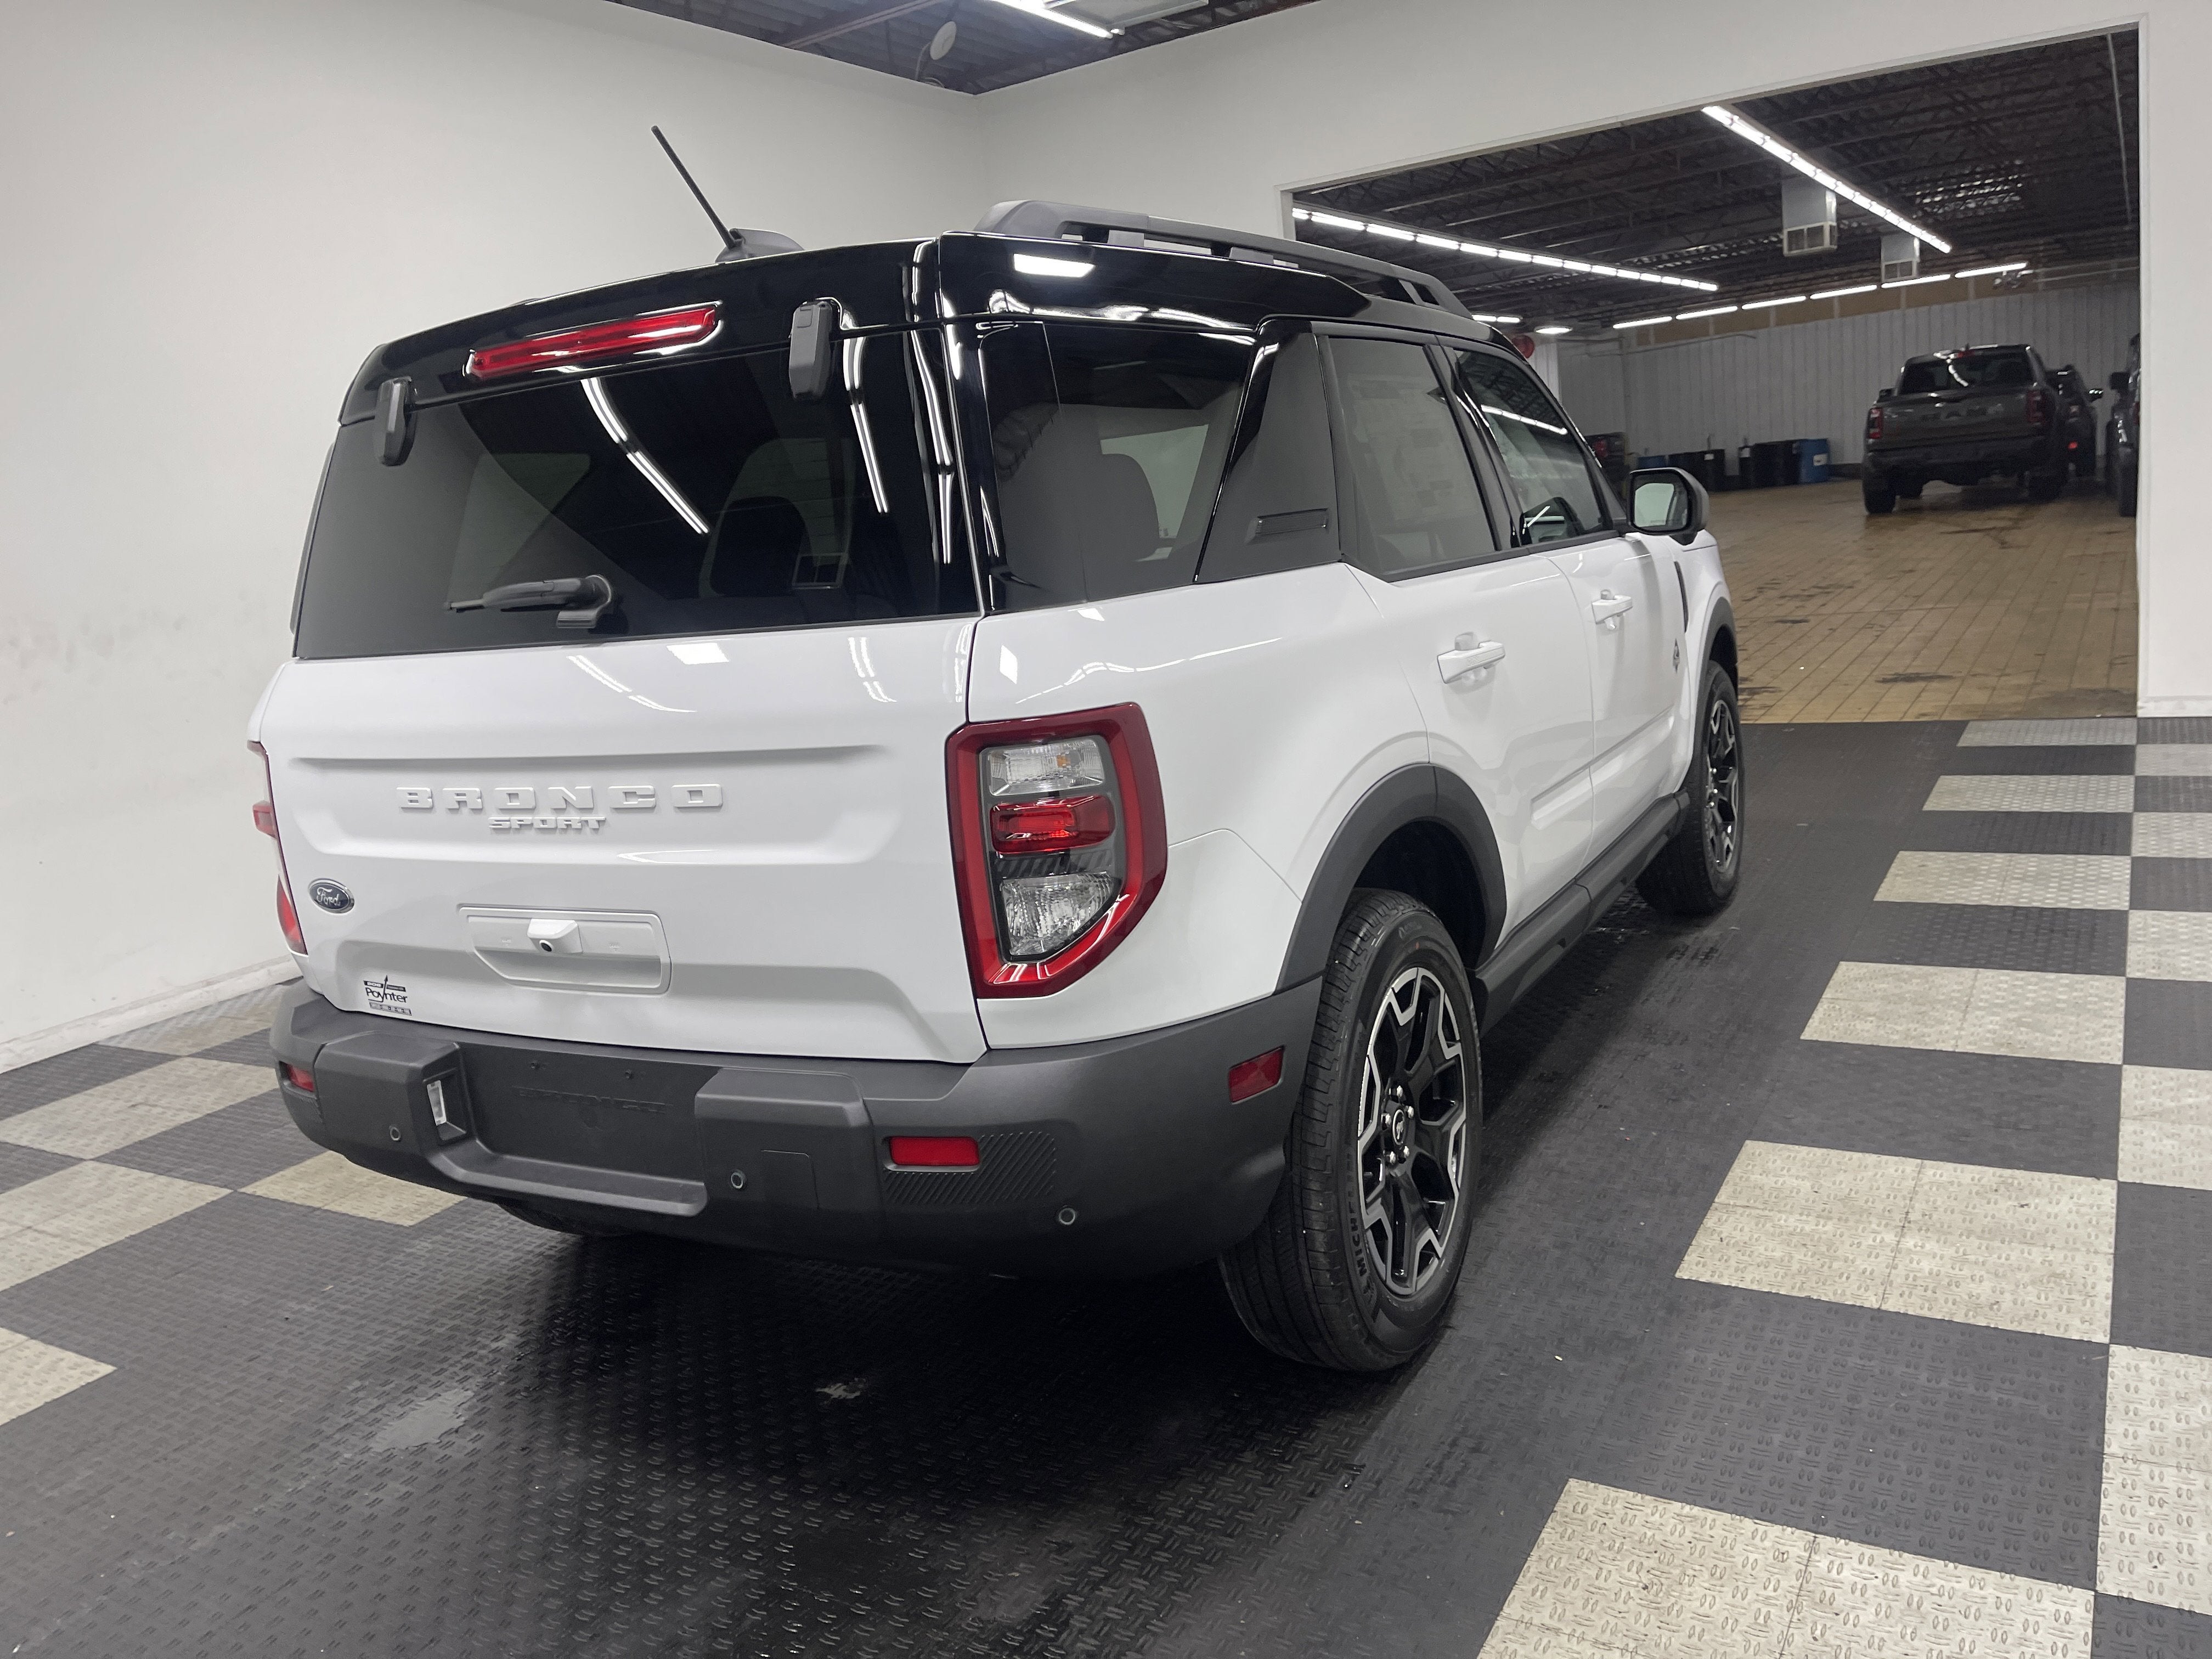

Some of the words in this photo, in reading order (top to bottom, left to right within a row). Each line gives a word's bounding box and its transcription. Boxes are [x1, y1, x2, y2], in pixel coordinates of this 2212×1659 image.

[396, 783, 724, 809] BRONCO
[488, 816, 606, 830] SPORT
[316, 887, 341, 906] Ford
[365, 987, 408, 1003] Poynter
